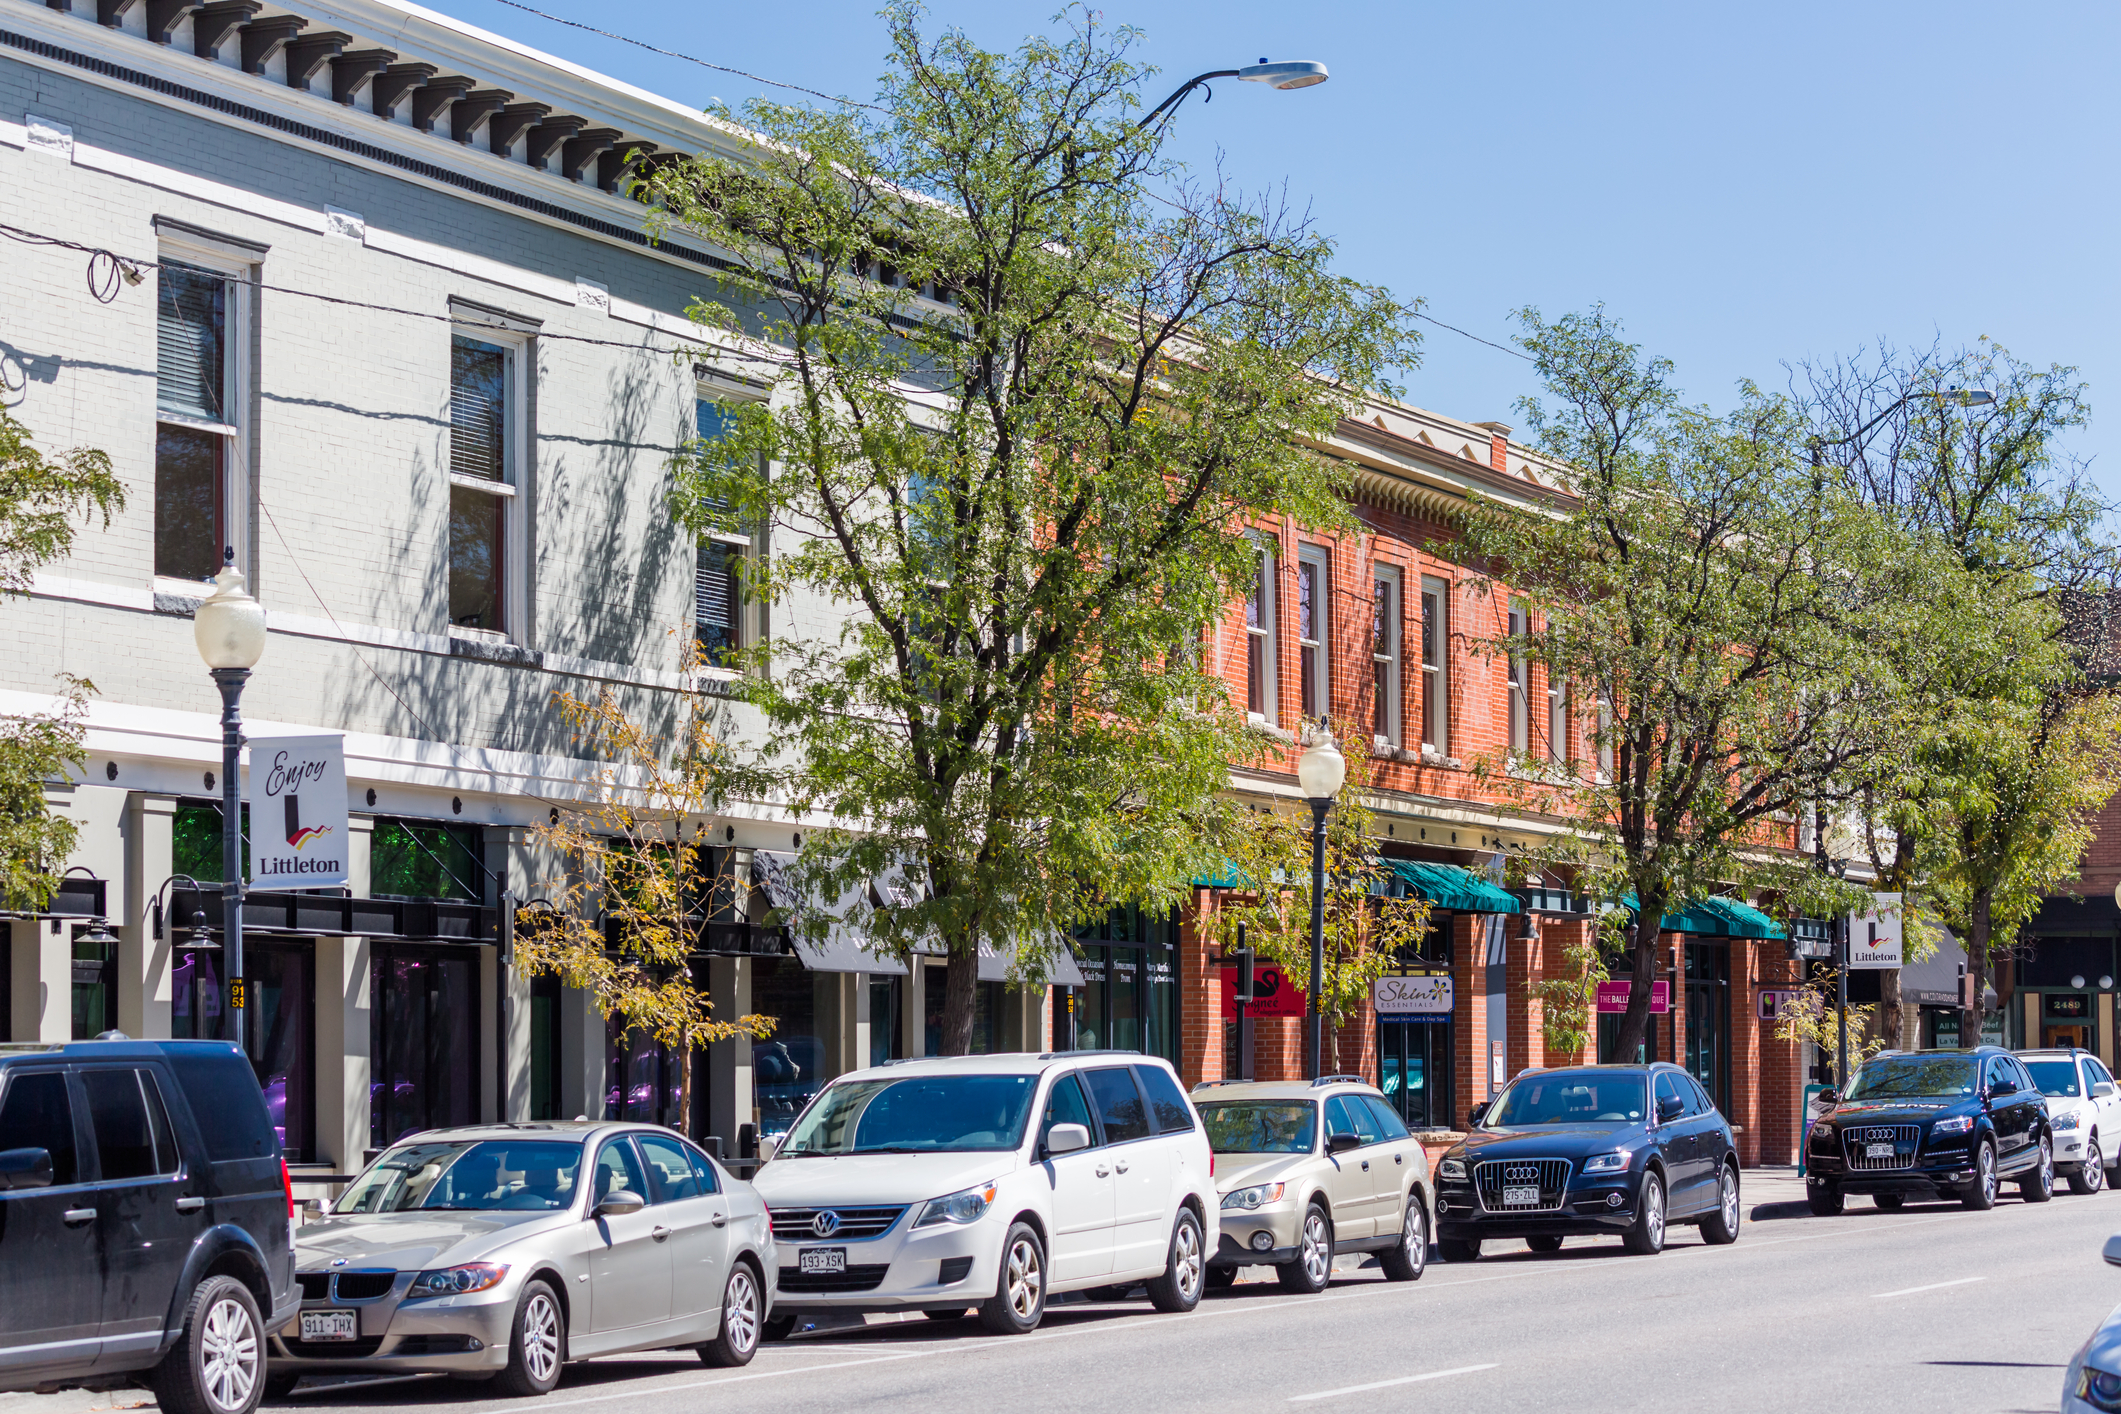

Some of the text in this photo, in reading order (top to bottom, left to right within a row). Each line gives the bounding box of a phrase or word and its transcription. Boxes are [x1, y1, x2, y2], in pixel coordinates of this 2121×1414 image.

[266, 751, 327, 797] Enjoy
[260, 856, 340, 875] Littleton
[1855, 952, 1897, 962] Littleton
[232, 985, 244, 996] 91
[1378, 980, 1431, 1002] Skin
[232, 997, 244, 1008] 53
[1600, 995, 1611, 1004] THE
[2053, 1001, 2081, 1009] 2489
[1260, 1009, 1281, 1017] elegant
